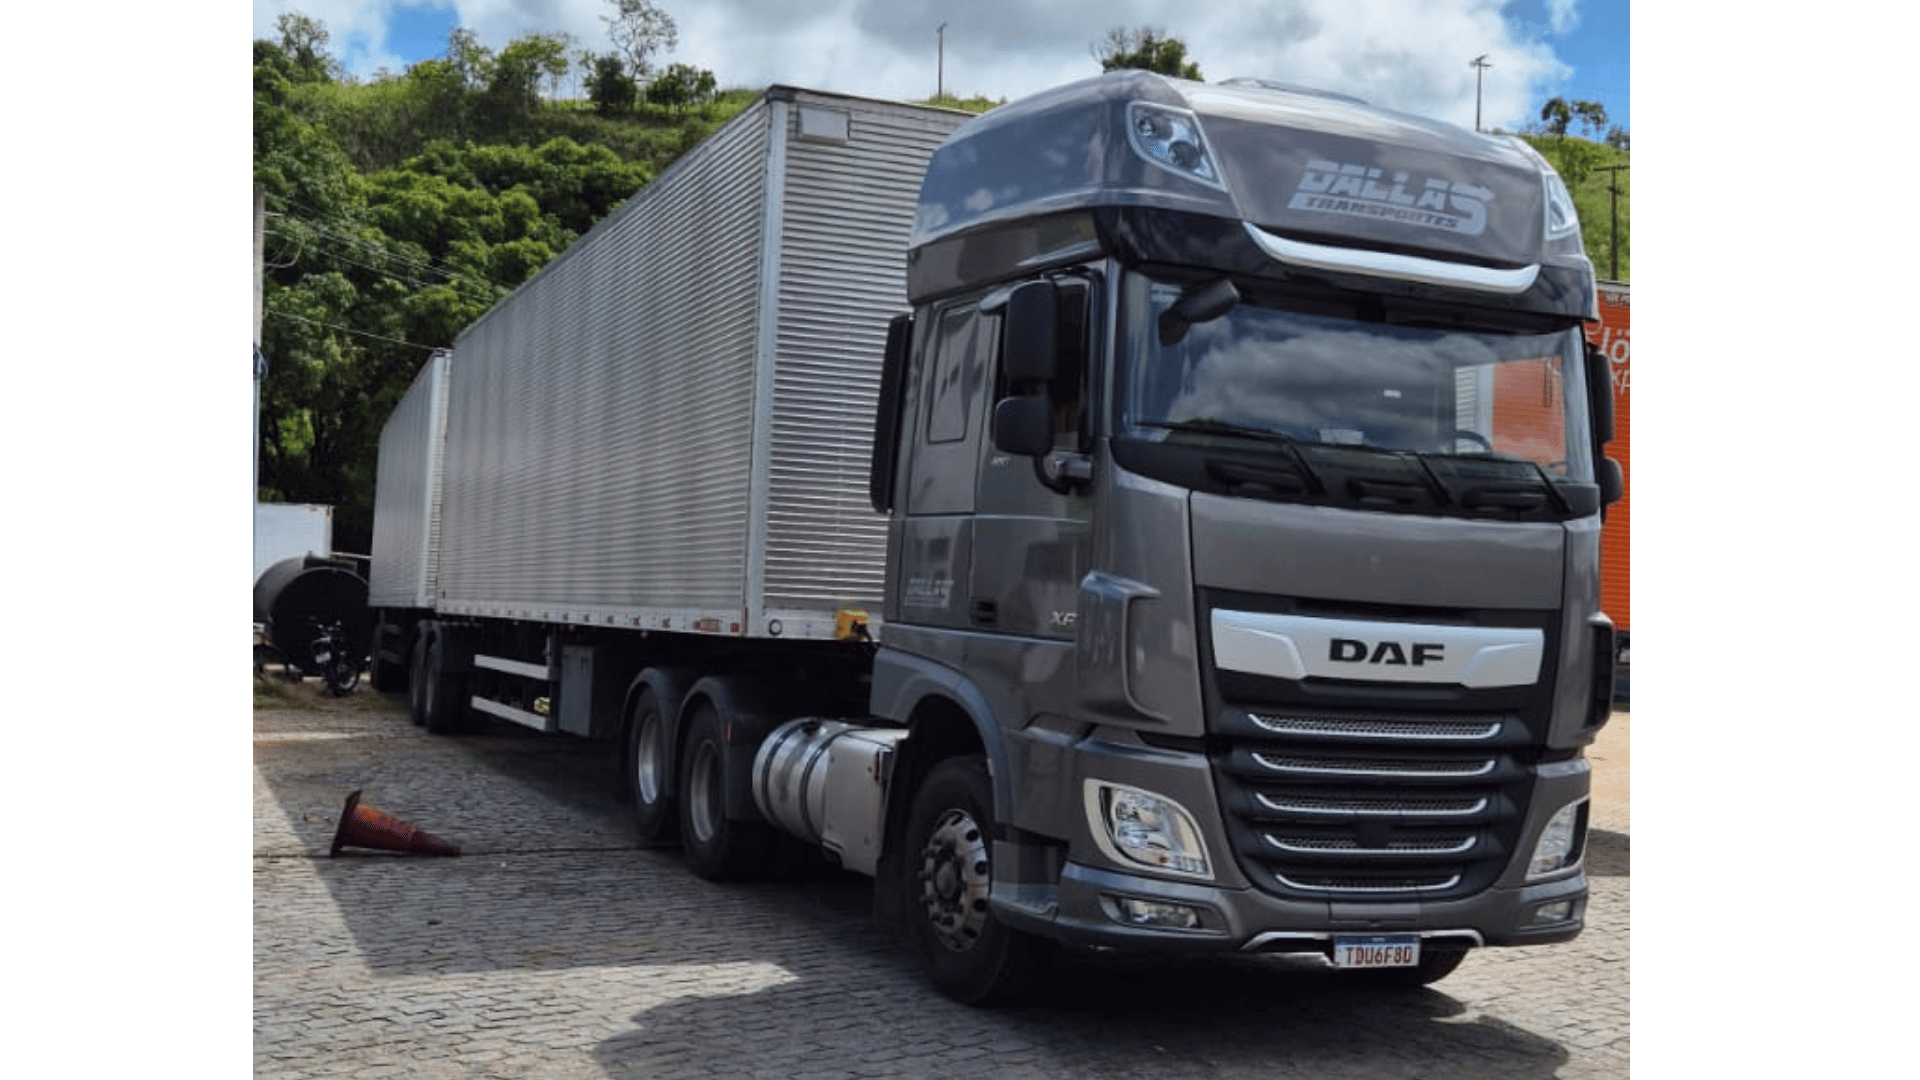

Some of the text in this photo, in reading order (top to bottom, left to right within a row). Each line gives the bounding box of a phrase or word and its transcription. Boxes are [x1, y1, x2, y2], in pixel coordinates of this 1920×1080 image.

[1291, 159, 1494, 234] DALLAS
[1304, 196, 1459, 229] TRANSPORTES
[1051, 611, 1078, 626] XF
[1329, 638, 1445, 666] DAF
[1344, 945, 1413, 965] TDU6F80
